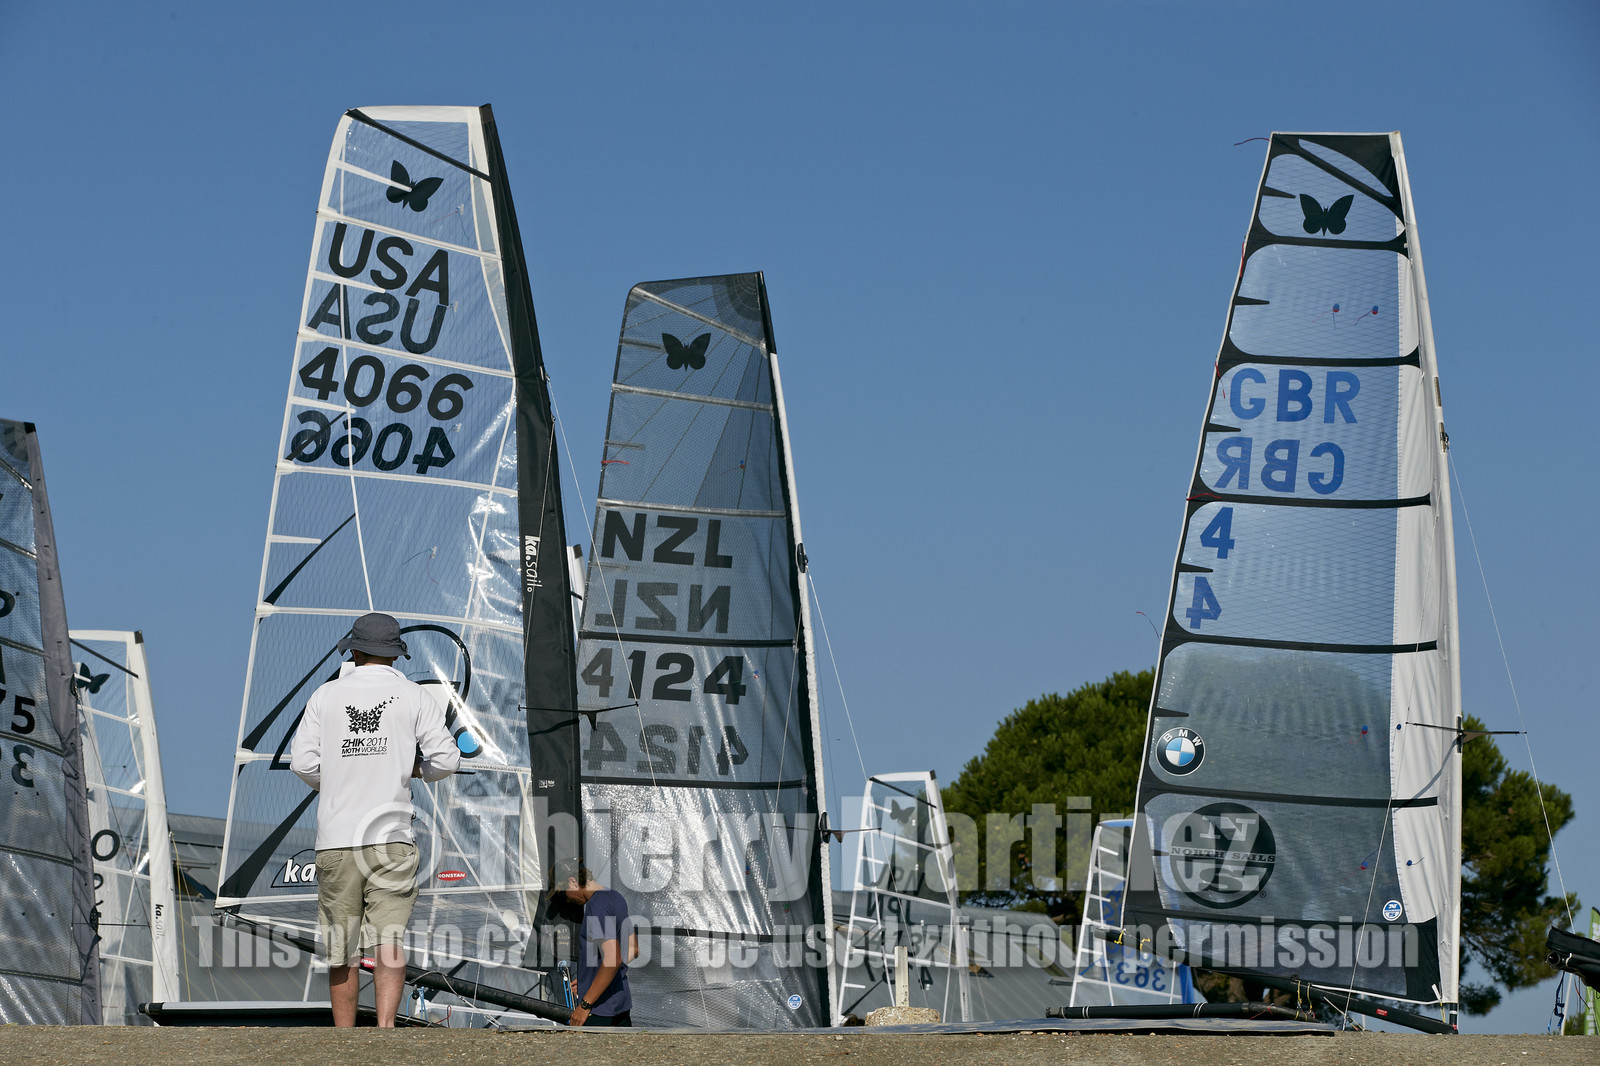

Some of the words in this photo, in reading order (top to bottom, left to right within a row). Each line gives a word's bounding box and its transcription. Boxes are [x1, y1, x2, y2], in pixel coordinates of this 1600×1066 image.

[328, 222, 449, 306] USA
[299, 346, 474, 421] 4066
[1230, 367, 1361, 424] GBR
[601, 510, 733, 569] NZL
[1200, 506, 1235, 559] 4
[580, 648, 746, 705] 4124
[342, 738, 365, 748] ZHIK
[366, 737, 387, 746] 2011
[1163, 729, 1202, 746] BMW
[437, 872, 466, 880] RONSTAN
[1170, 847, 1224, 858] NORTH
[1232, 851, 1277, 863] SAILS
